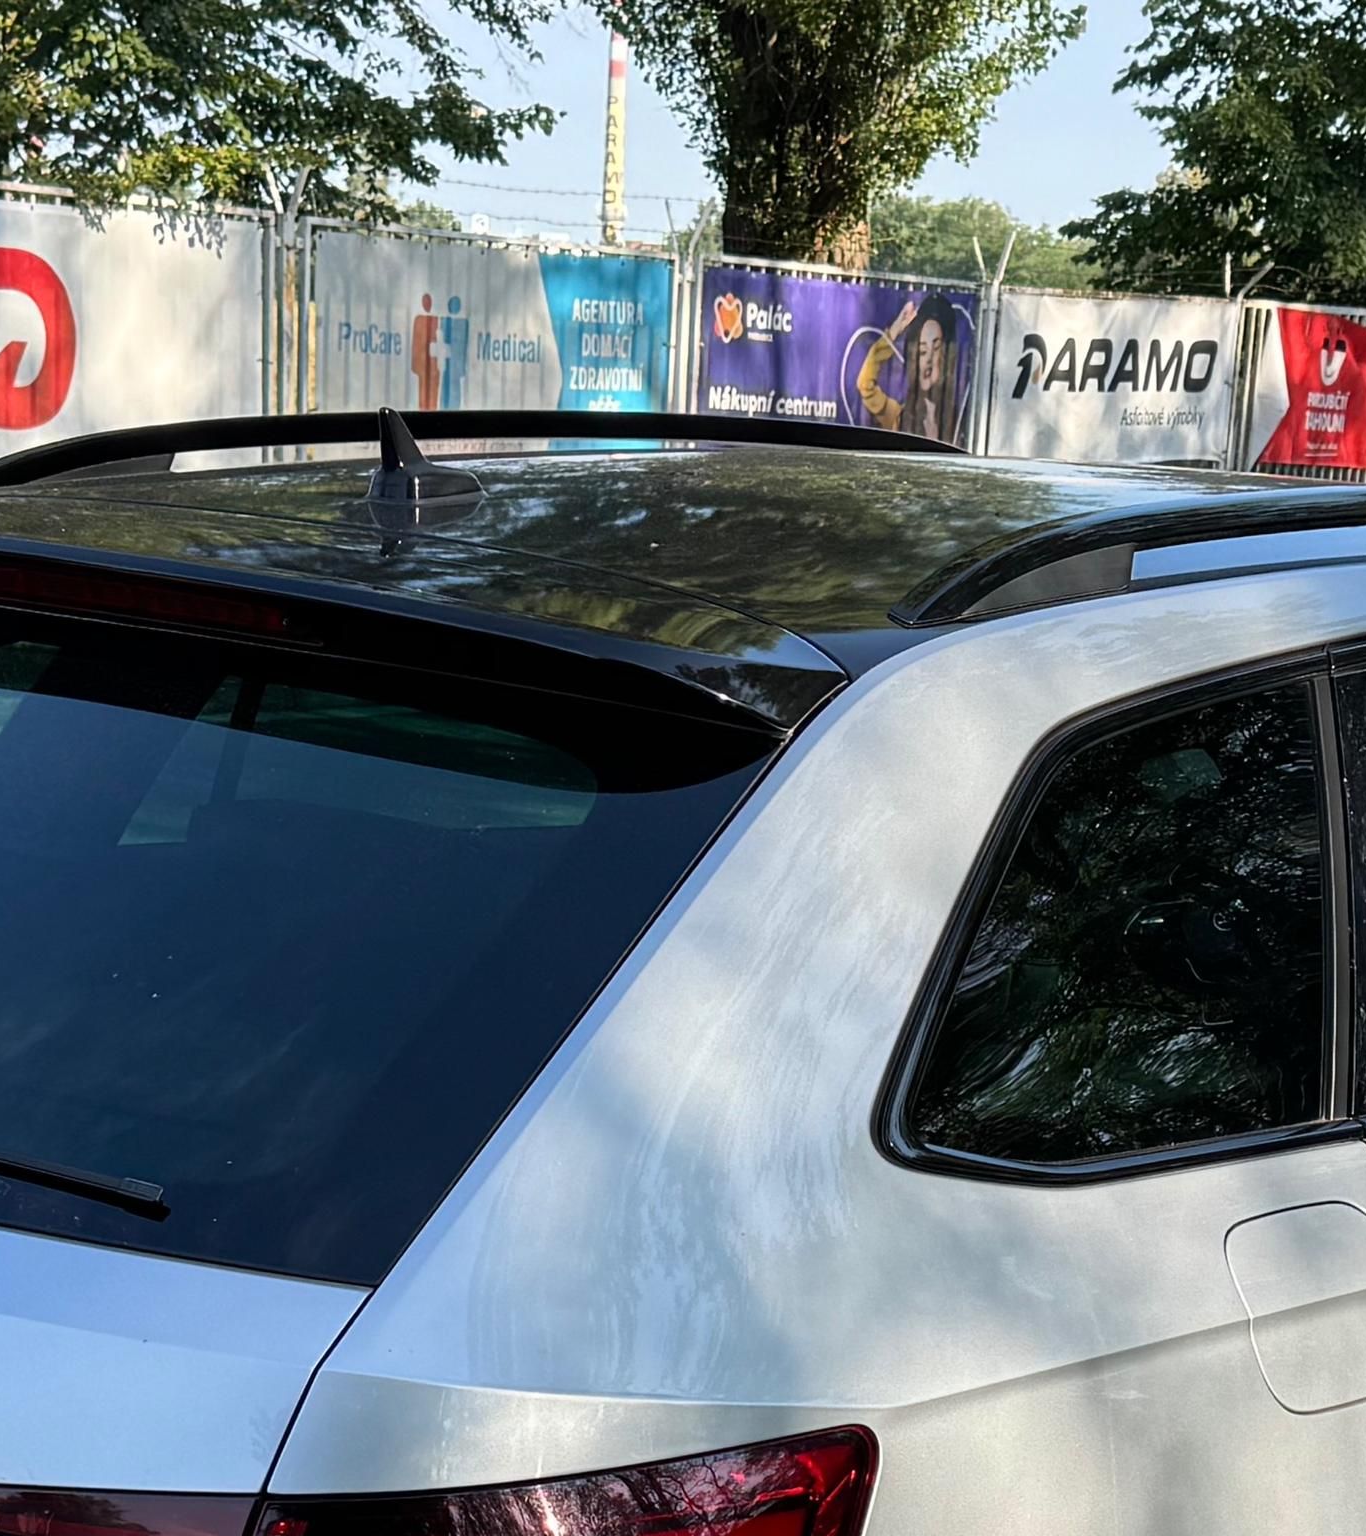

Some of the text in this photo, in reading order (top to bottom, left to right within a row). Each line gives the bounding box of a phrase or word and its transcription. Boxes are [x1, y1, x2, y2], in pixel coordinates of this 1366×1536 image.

[572, 297, 644, 326] AGENTURA
[746, 301, 793, 332] Palác
[337, 321, 542, 364] ProCare Medical
[581, 328, 635, 359] DOMÁCÍ
[569, 363, 644, 392] ZDRAVOTNÍ
[1011, 333, 1219, 400] PARAMO
[708, 385, 837, 418] Nákupní centrum
